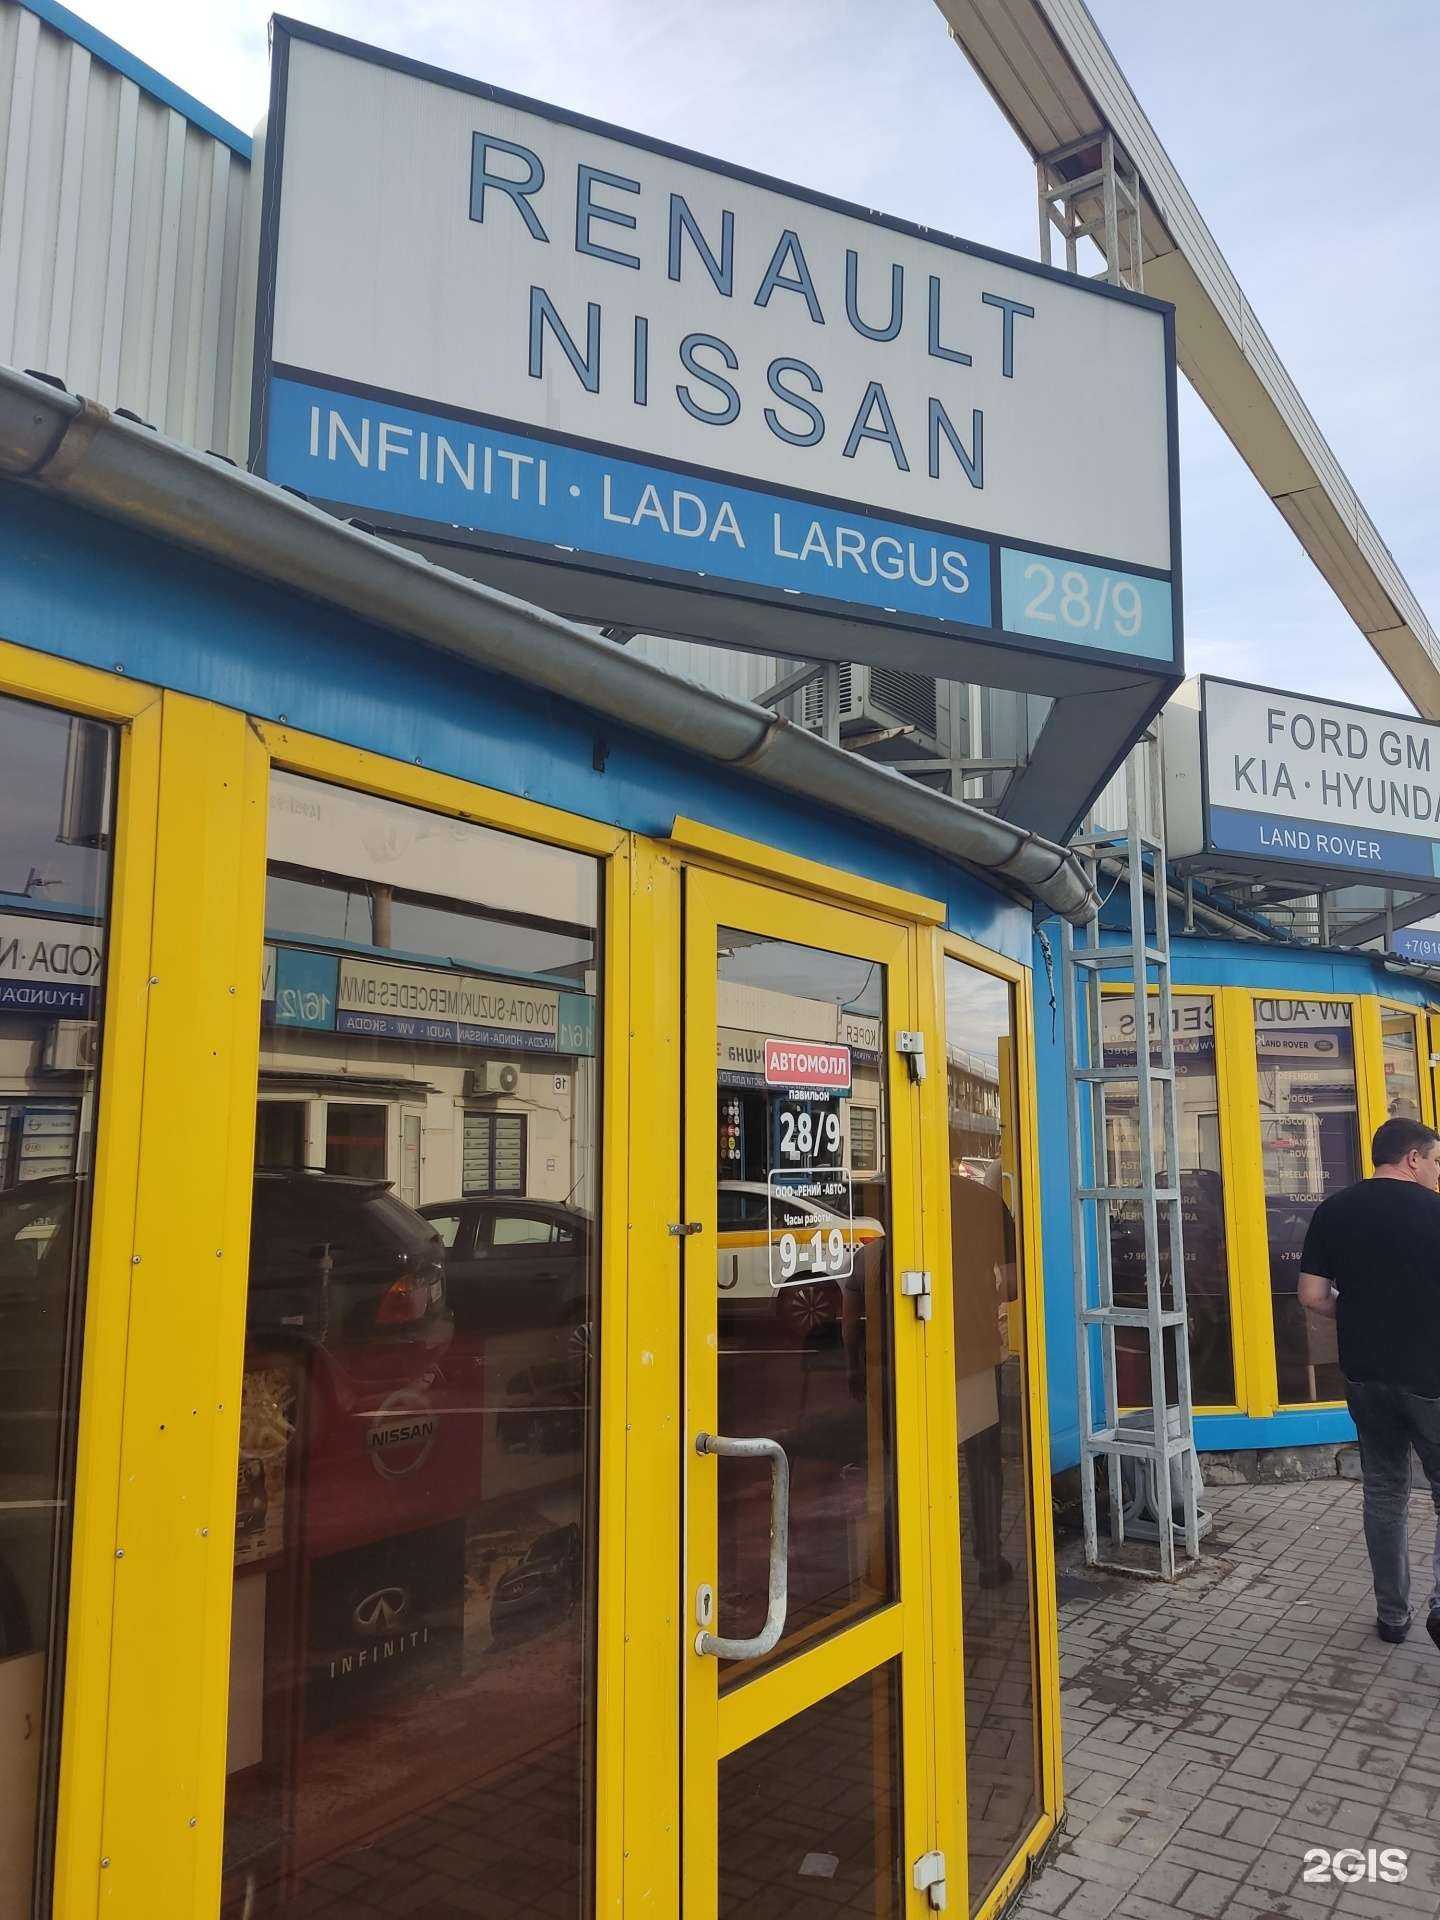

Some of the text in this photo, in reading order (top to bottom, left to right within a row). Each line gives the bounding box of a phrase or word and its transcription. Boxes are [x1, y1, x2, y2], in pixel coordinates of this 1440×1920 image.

[469, 131, 1035, 379] RENAULT
[528, 285, 985, 490] NISSAN
[308, 406, 969, 596] INFINITI LADA LARGUS
[1022, 562, 1143, 638] 28/9
[1266, 707, 1431, 772] FORD GM
[1234, 754, 1297, 800] KIA
[1259, 826, 1382, 860] LAND ROVER
[769, 1051, 847, 1076] АВТОМОЛЛ
[1261, 1039, 1282, 1047] LAND
[1283, 1040, 1309, 1048] ROVER
[788, 1089, 830, 1102] павильон
[780, 1111, 840, 1157] 28/9
[783, 1213, 804, 1226] Часы
[780, 1228, 844, 1278] 9-19
[371, 1421, 434, 1447] NISSAN
[330, 1627, 431, 1679] INFINITI
